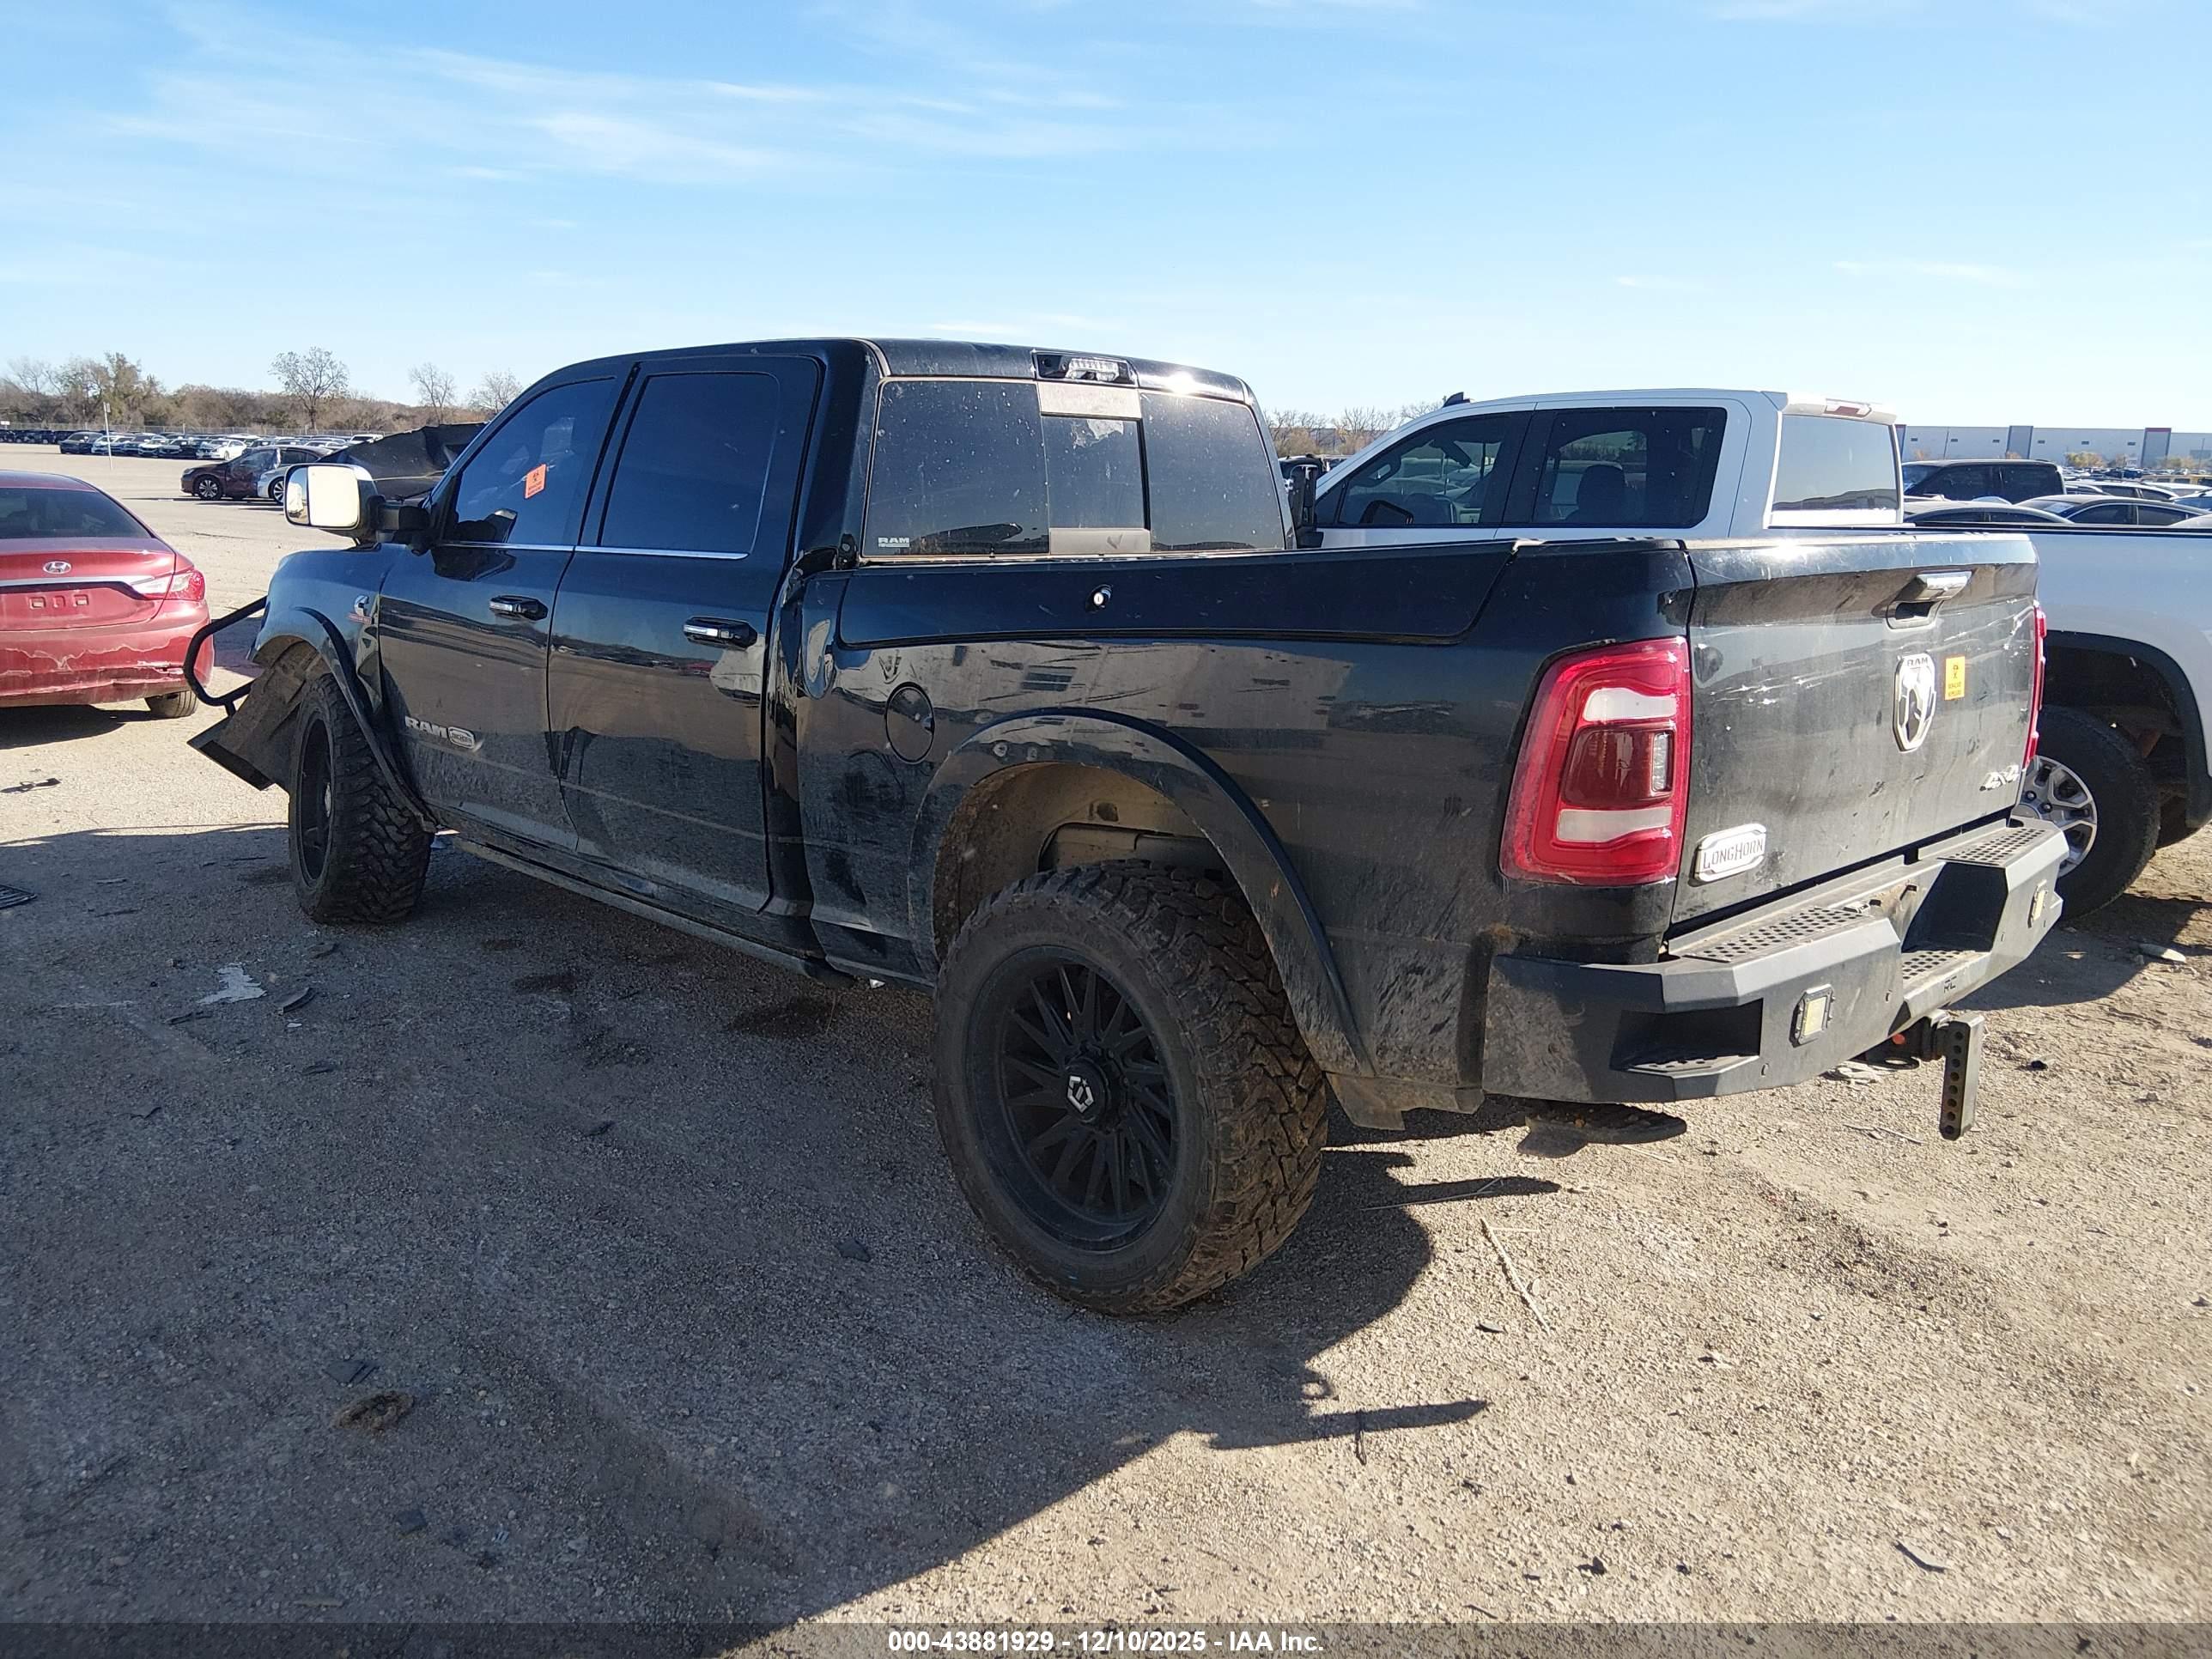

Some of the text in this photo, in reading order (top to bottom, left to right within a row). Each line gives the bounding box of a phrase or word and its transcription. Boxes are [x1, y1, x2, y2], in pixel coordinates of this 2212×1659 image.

[1906, 657, 1929, 666] RAM
[404, 715, 447, 738] RAM
[1703, 838, 1764, 869] LONGHORN
